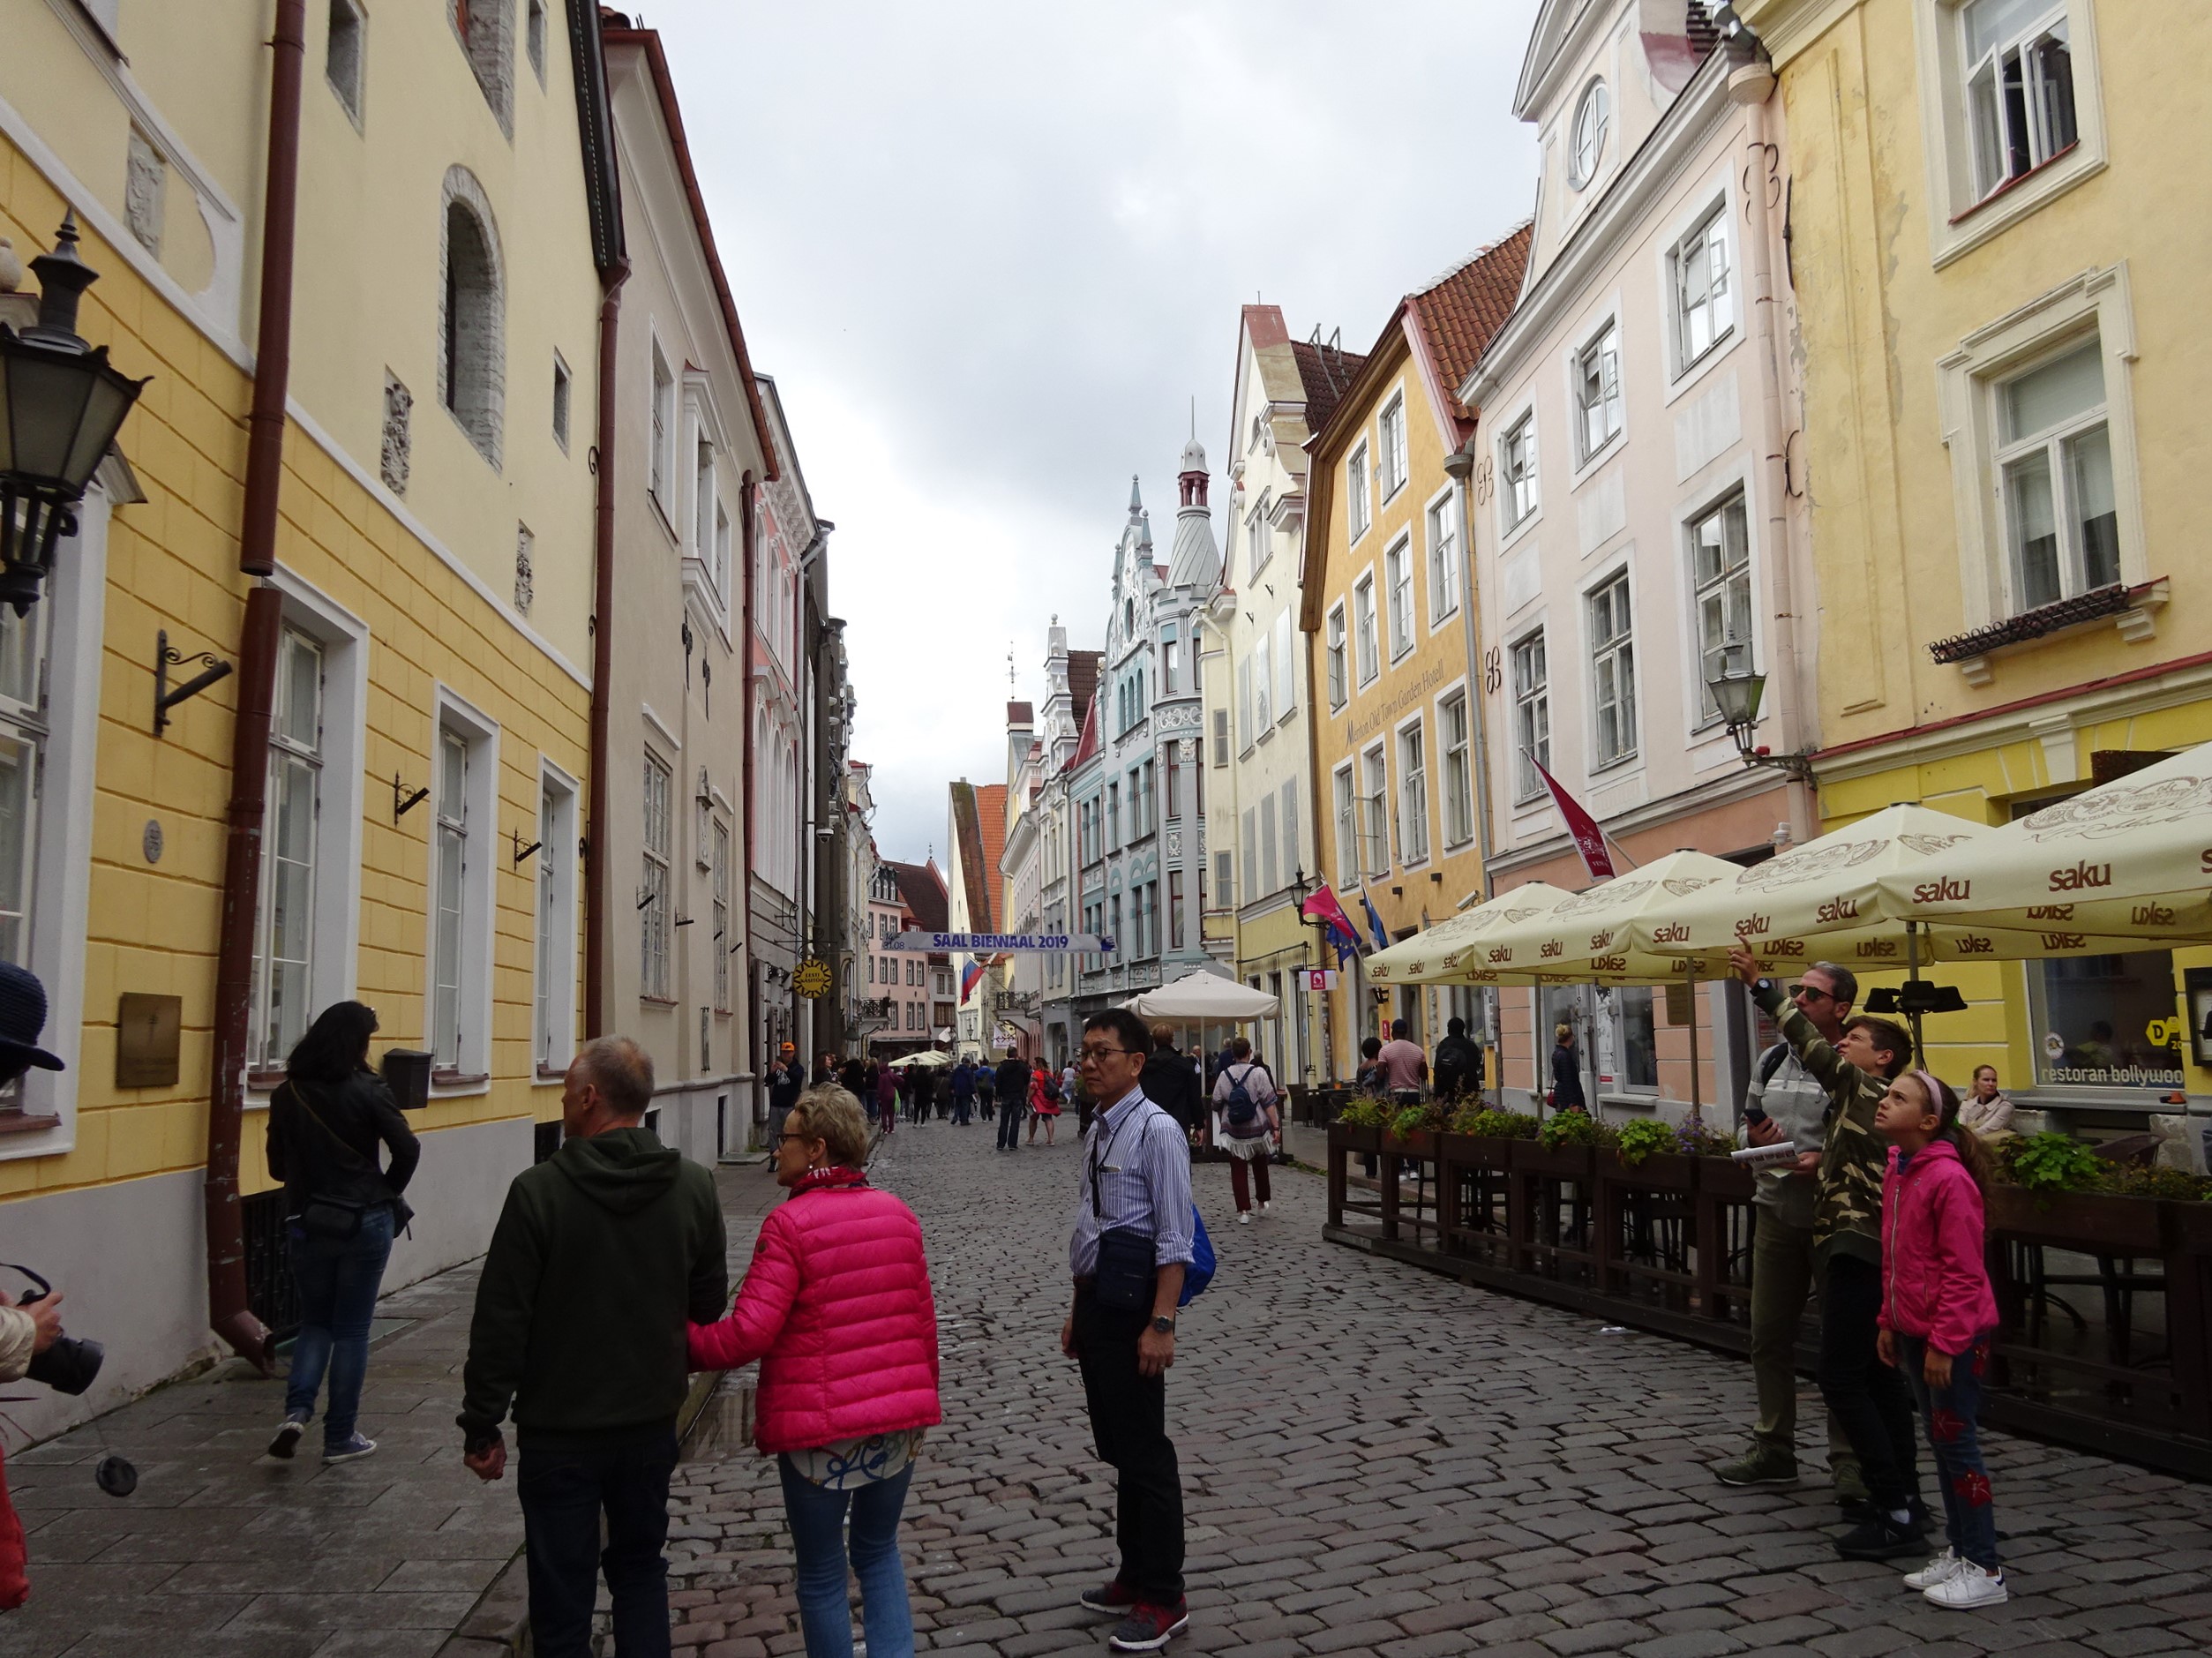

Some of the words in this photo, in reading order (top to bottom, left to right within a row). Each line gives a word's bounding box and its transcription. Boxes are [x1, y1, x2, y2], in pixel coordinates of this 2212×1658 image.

[1369, 709, 1380, 731] Old
[1381, 701, 1397, 722] Town
[1398, 681, 1422, 709] Garden
[1422, 658, 1444, 692] Hotell
[2049, 859, 2111, 892] saku
[1912, 875, 1971, 904] saku
[1816, 896, 1860, 924] saku
[1653, 921, 1691, 944] saku
[1733, 912, 1771, 937] saku
[933, 934, 968, 948] SAAL
[971, 934, 1035, 949] BIENNAAL
[1038, 935, 1069, 949] 2019
[1541, 938, 1563, 958] saku
[1590, 928, 1615, 950] saku
[1442, 953, 1460, 969] saku
[1488, 944, 1512, 964] saku
[1371, 962, 1391, 978] saku
[1408, 958, 1426, 975] saku
[2152, 1024, 2163, 1039] D
[2042, 1067, 2107, 1082] restoran
